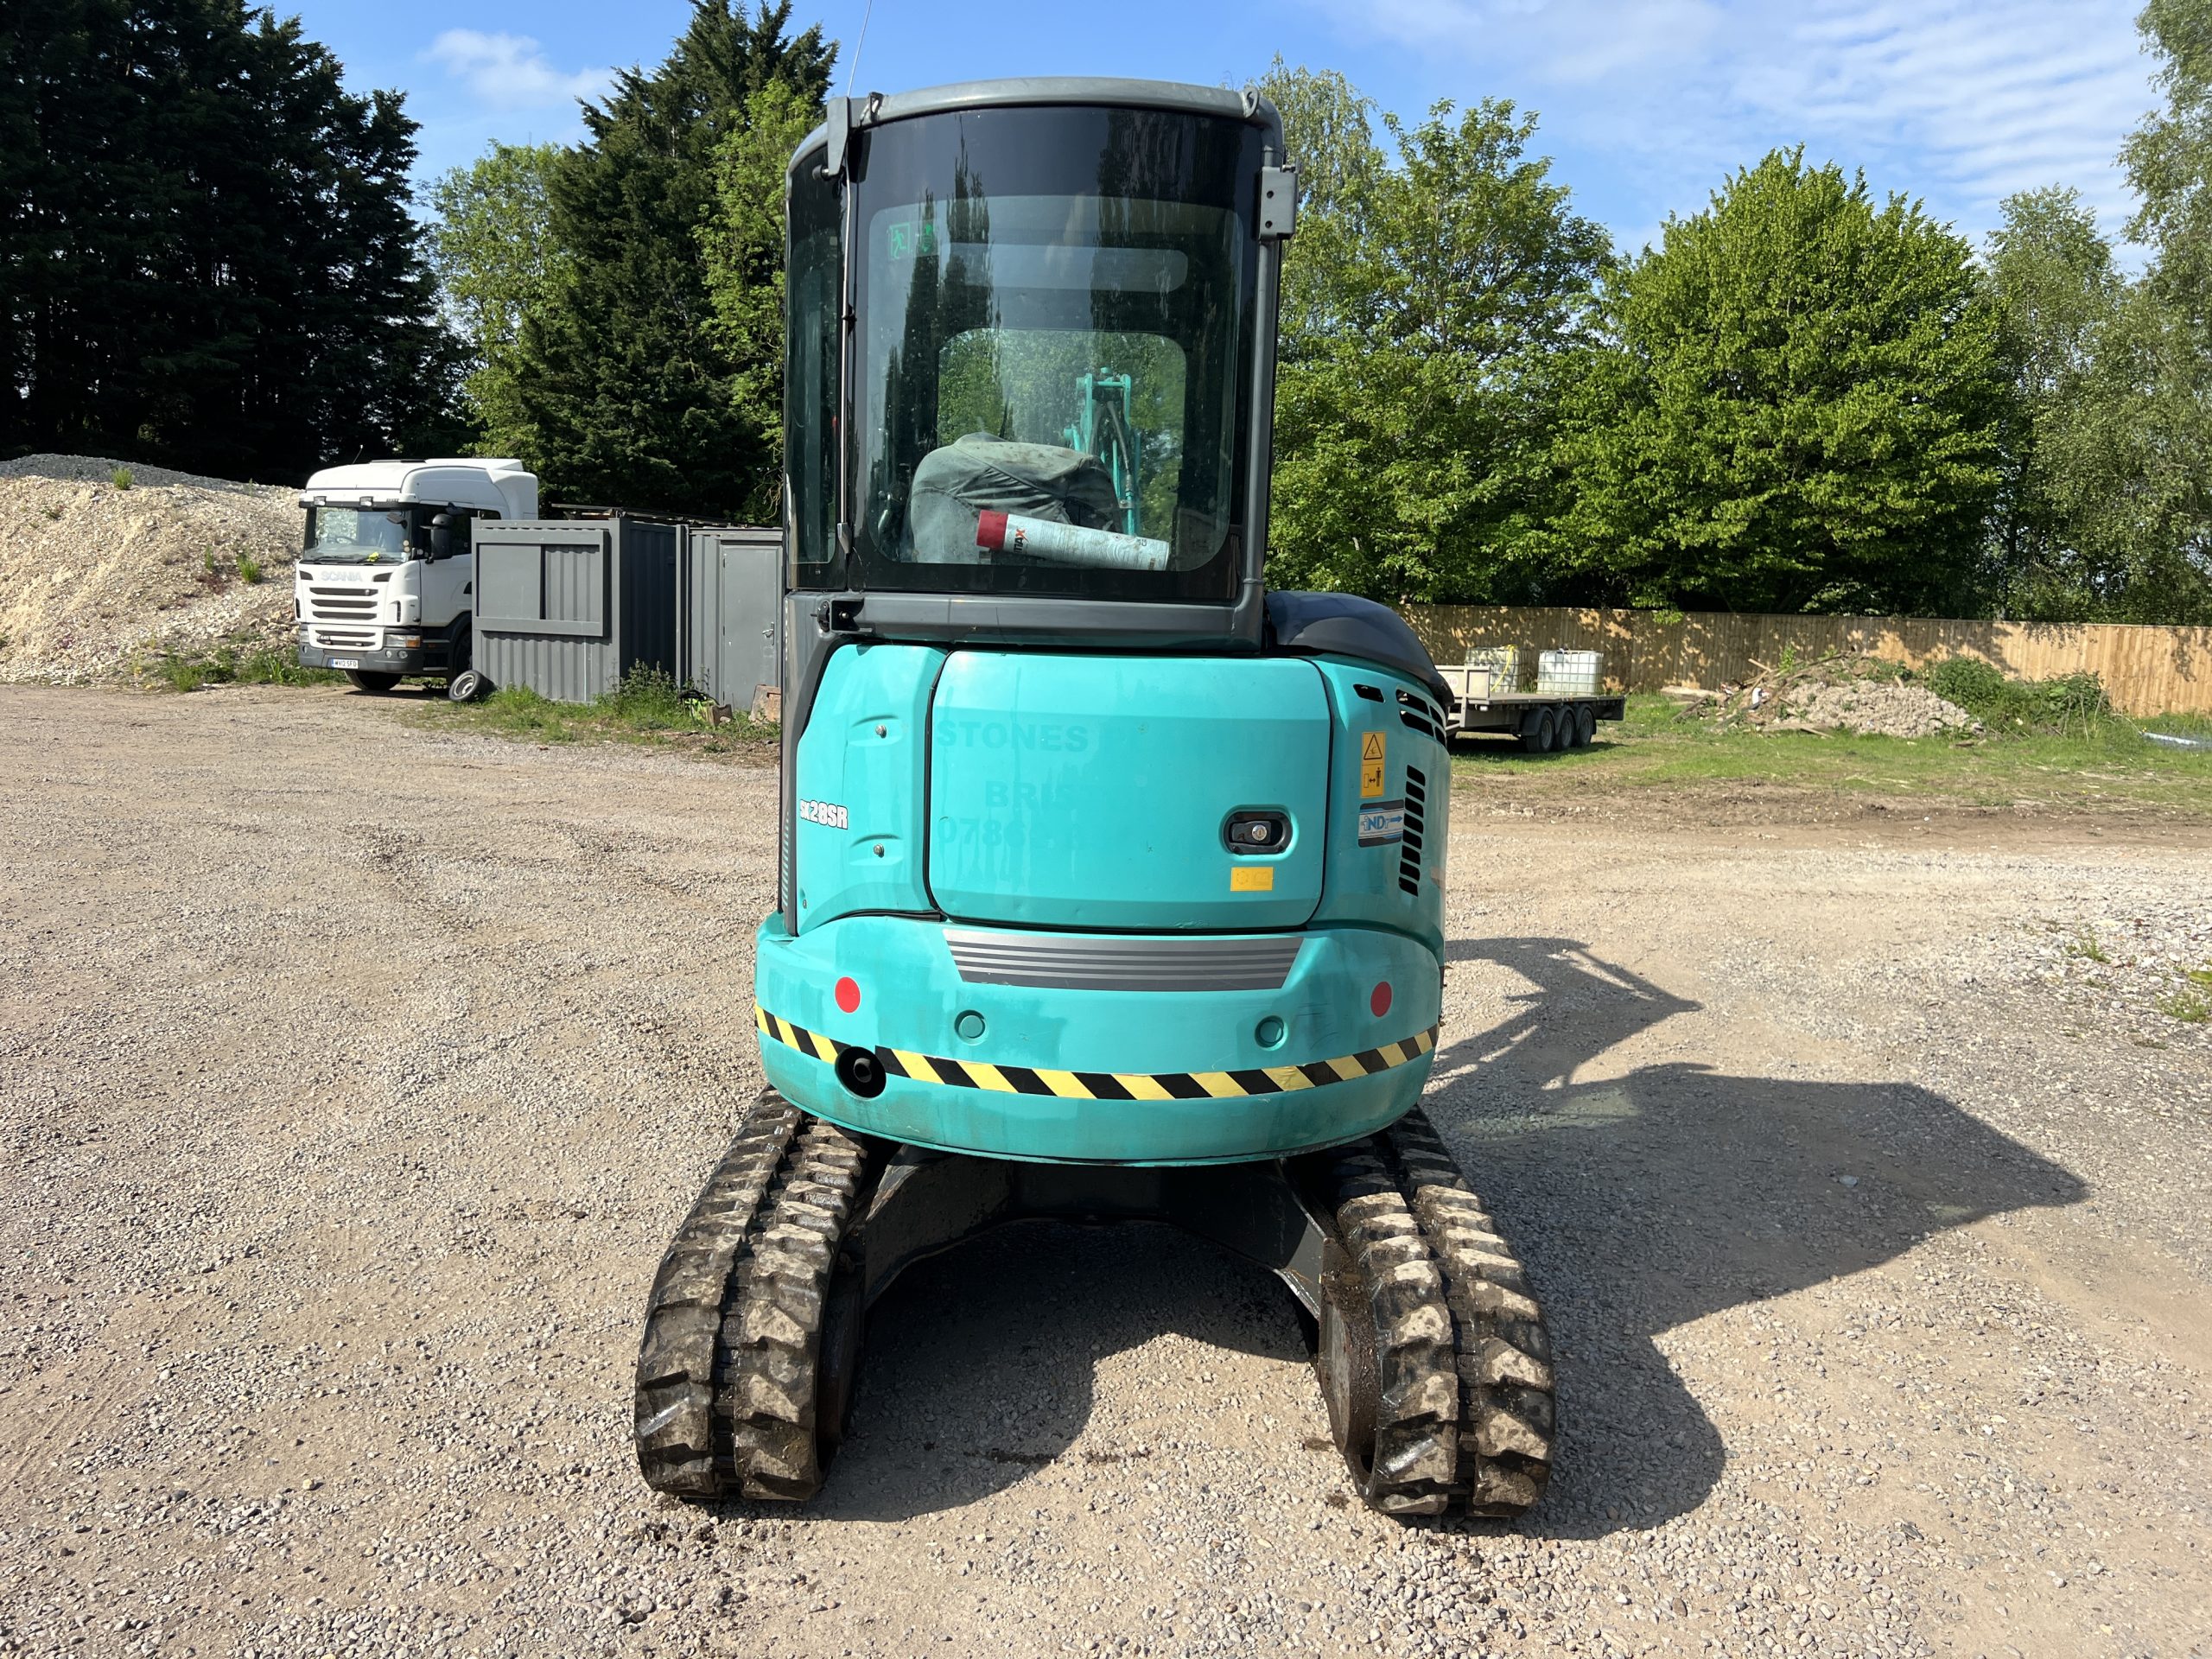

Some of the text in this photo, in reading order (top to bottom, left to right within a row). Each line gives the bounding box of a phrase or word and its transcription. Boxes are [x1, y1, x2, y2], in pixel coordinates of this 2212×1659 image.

[321, 570, 363, 582] SCANIA
[938, 720, 1088, 753] STONES
[799, 799, 849, 830] SK28SR
